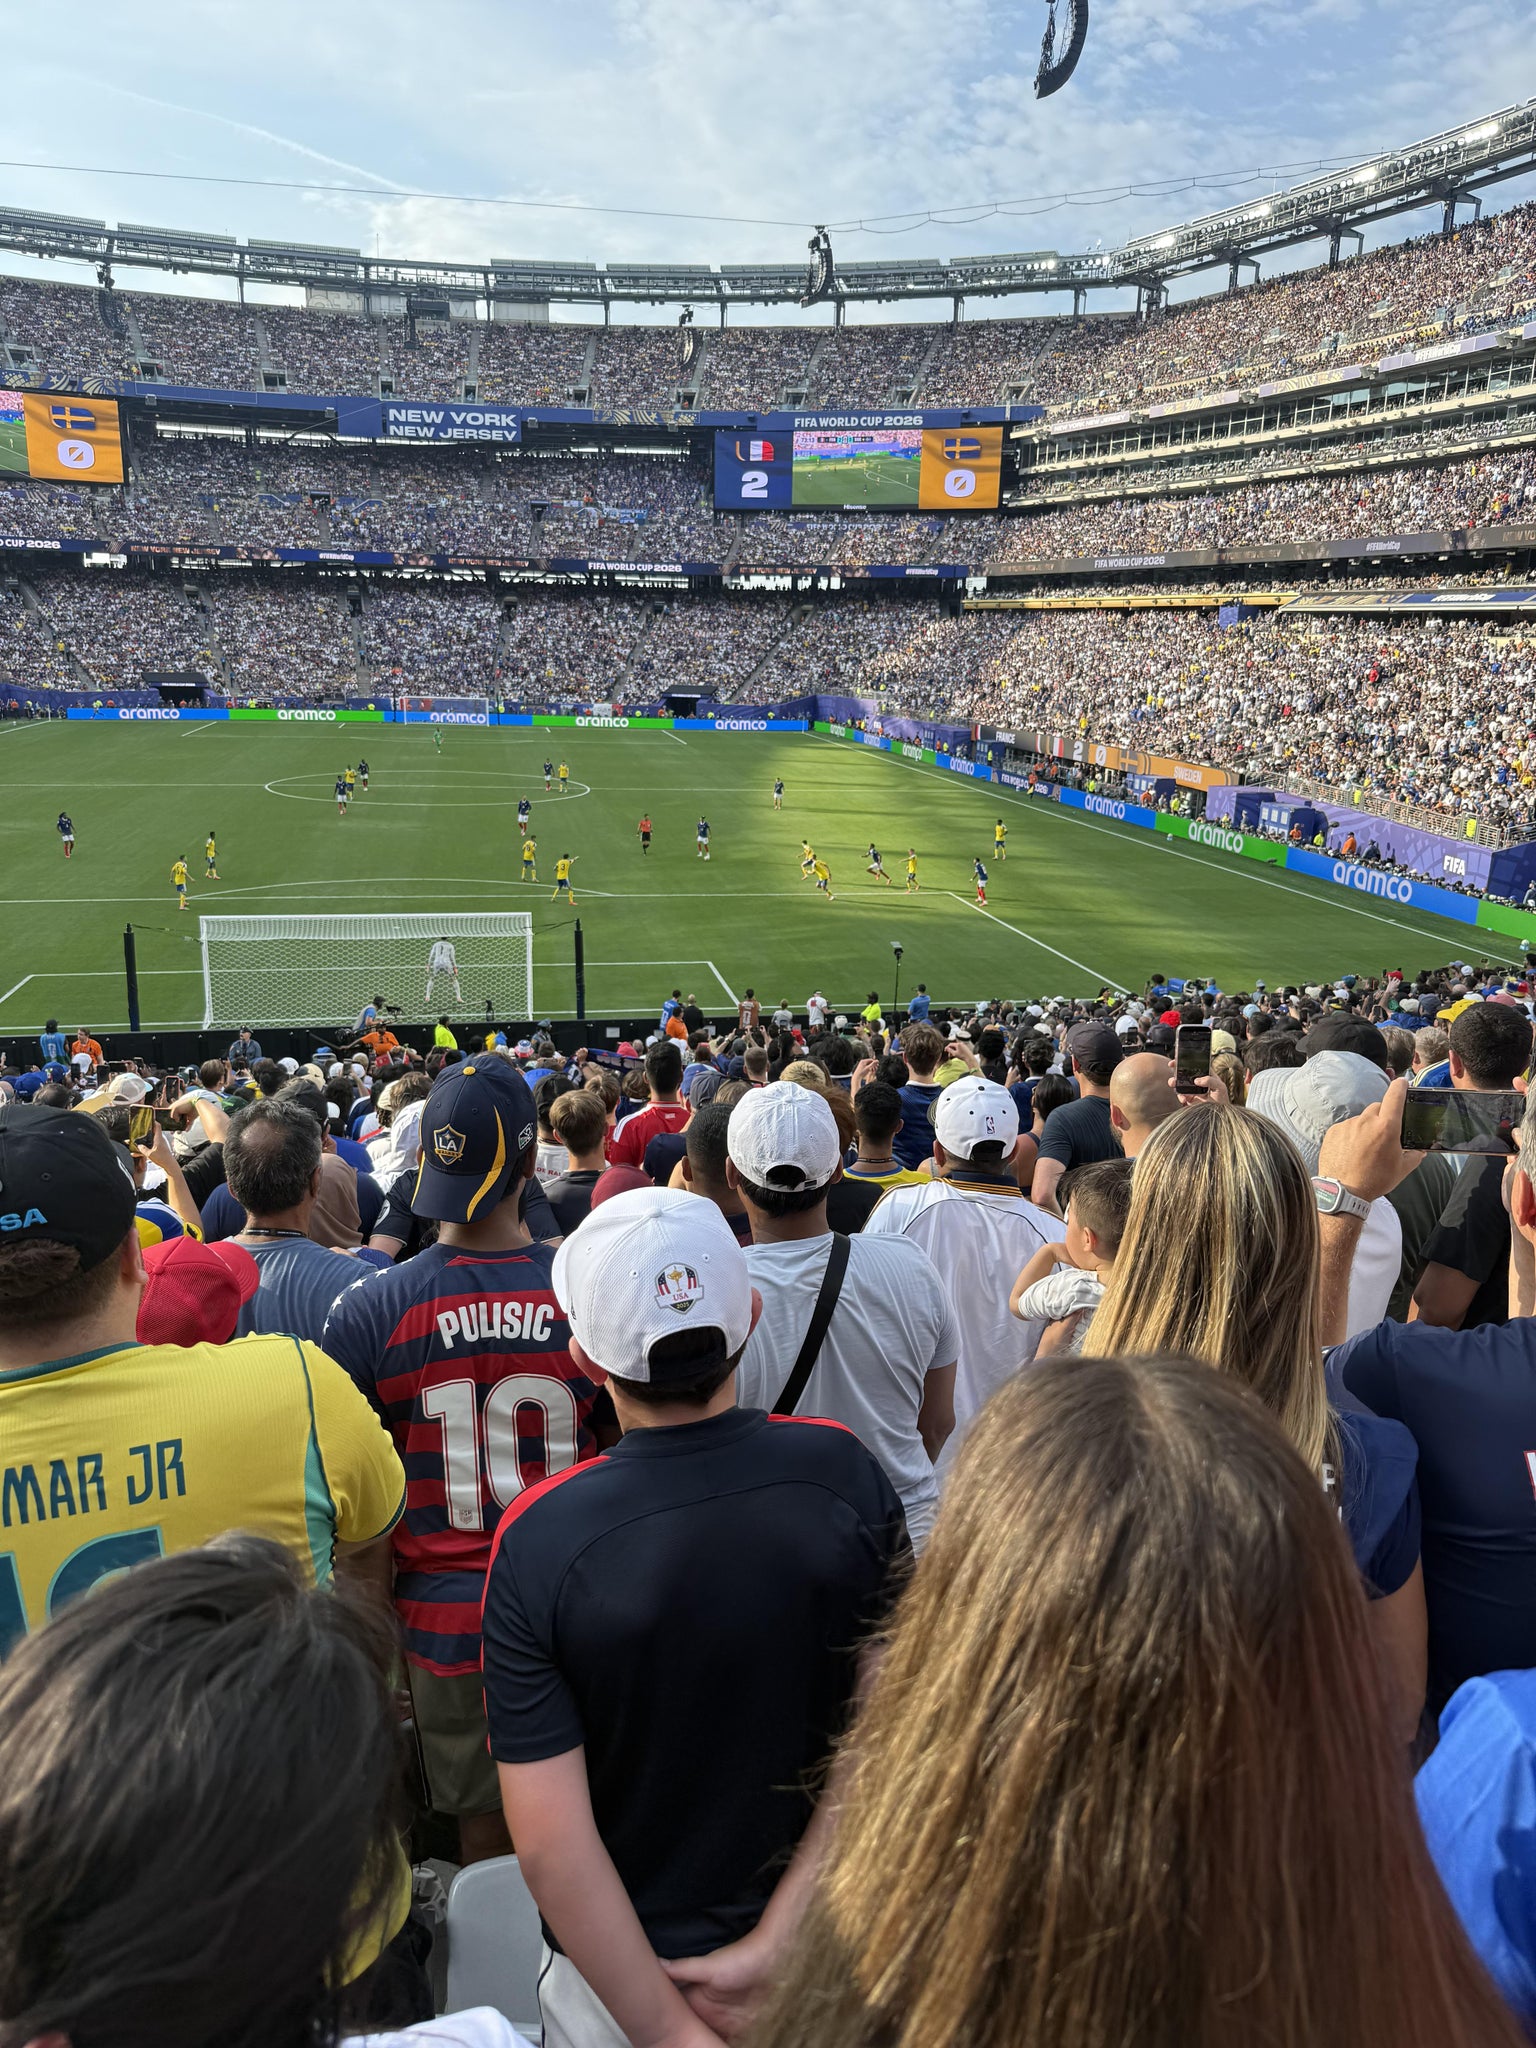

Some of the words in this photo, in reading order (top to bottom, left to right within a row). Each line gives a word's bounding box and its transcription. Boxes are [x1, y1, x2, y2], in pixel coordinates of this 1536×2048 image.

[389, 408, 445, 424] NEW
[450, 412, 518, 428] YORK
[794, 418, 818, 428] FIFA
[819, 417, 858, 427] WORLD
[859, 416, 883, 426] CUP
[883, 415, 923, 426] 2026
[389, 424, 435, 438] NEW
[439, 427, 517, 441] JERSEY
[58, 439, 95, 469] 0
[741, 471, 768, 498] 2
[944, 469, 976, 498] 0
[5, 539, 25, 547] CUP
[26, 540, 61, 549] 2026
[588, 562, 606, 570] FIFA
[606, 562, 636, 571] WORLD
[637, 563, 653, 571] CUP
[653, 564, 682, 572] 2026
[1094, 560, 1108, 569] FIFA
[1108, 558, 1130, 567] WORLD
[1131, 557, 1143, 566] CUP
[1143, 556, 1165, 565] 2026
[119, 708, 180, 720] aramco
[277, 709, 336, 721] aramco
[430, 711, 486, 724] aramco
[575, 716, 629, 728] aramco
[715, 719, 767, 731] aramco
[995, 731, 1016, 744] FRANCE
[1073, 740, 1083, 761] 2
[950, 756, 975, 776] aramco
[1174, 765, 1203, 783] SWEDEN
[1001, 773, 1010, 783] FIFA
[1084, 794, 1125, 820] aramco
[1188, 821, 1244, 854] aramco
[560, 863, 566, 871] 3
[1443, 855, 1465, 876] FIFA
[1333, 861, 1413, 903] aramco
[439, 1136, 458, 1151] LA
[0, 1208, 48, 1231] SA
[672, 1292, 689, 1301] USA
[437, 1302, 555, 1350] PULISIC
[422, 1373, 578, 1532] 10
[2, 1453, 107, 1527] MAR
[126, 1438, 186, 1505] JR
